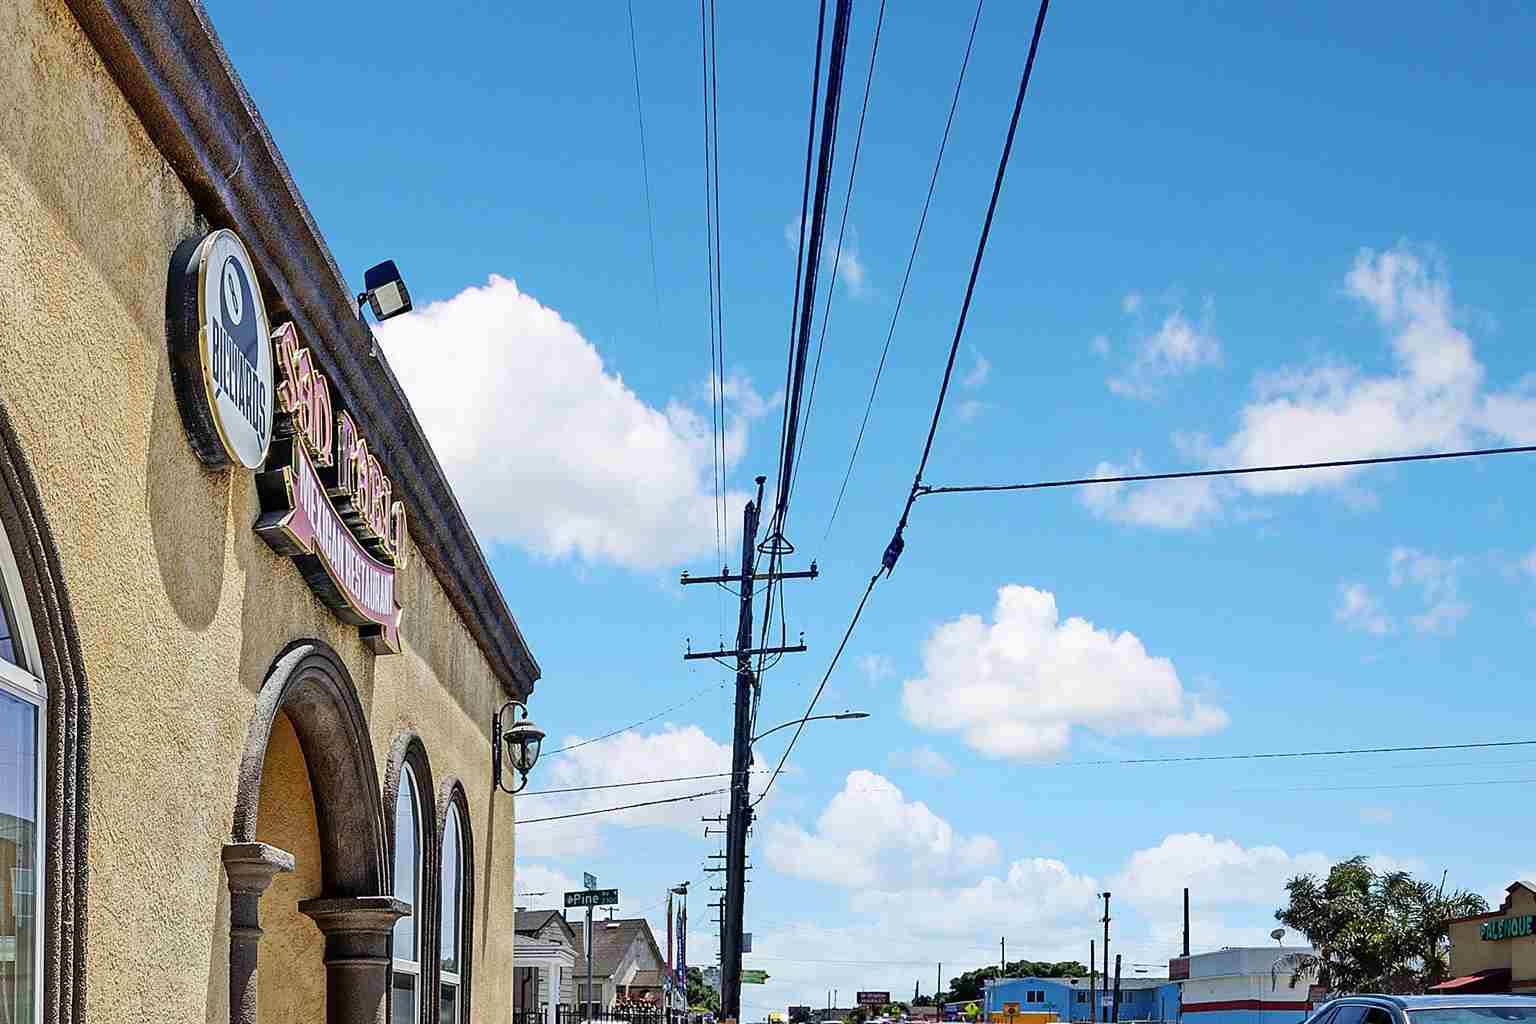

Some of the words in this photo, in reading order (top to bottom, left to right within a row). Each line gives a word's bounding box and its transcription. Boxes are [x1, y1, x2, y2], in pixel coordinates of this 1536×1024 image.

[227, 272, 239, 318] 8
[212, 316, 267, 442] BILLIARDS
[299, 456, 346, 578] MEXICAN
[345, 543, 394, 616] RESTAURANT
[573, 893, 599, 905] Pine
